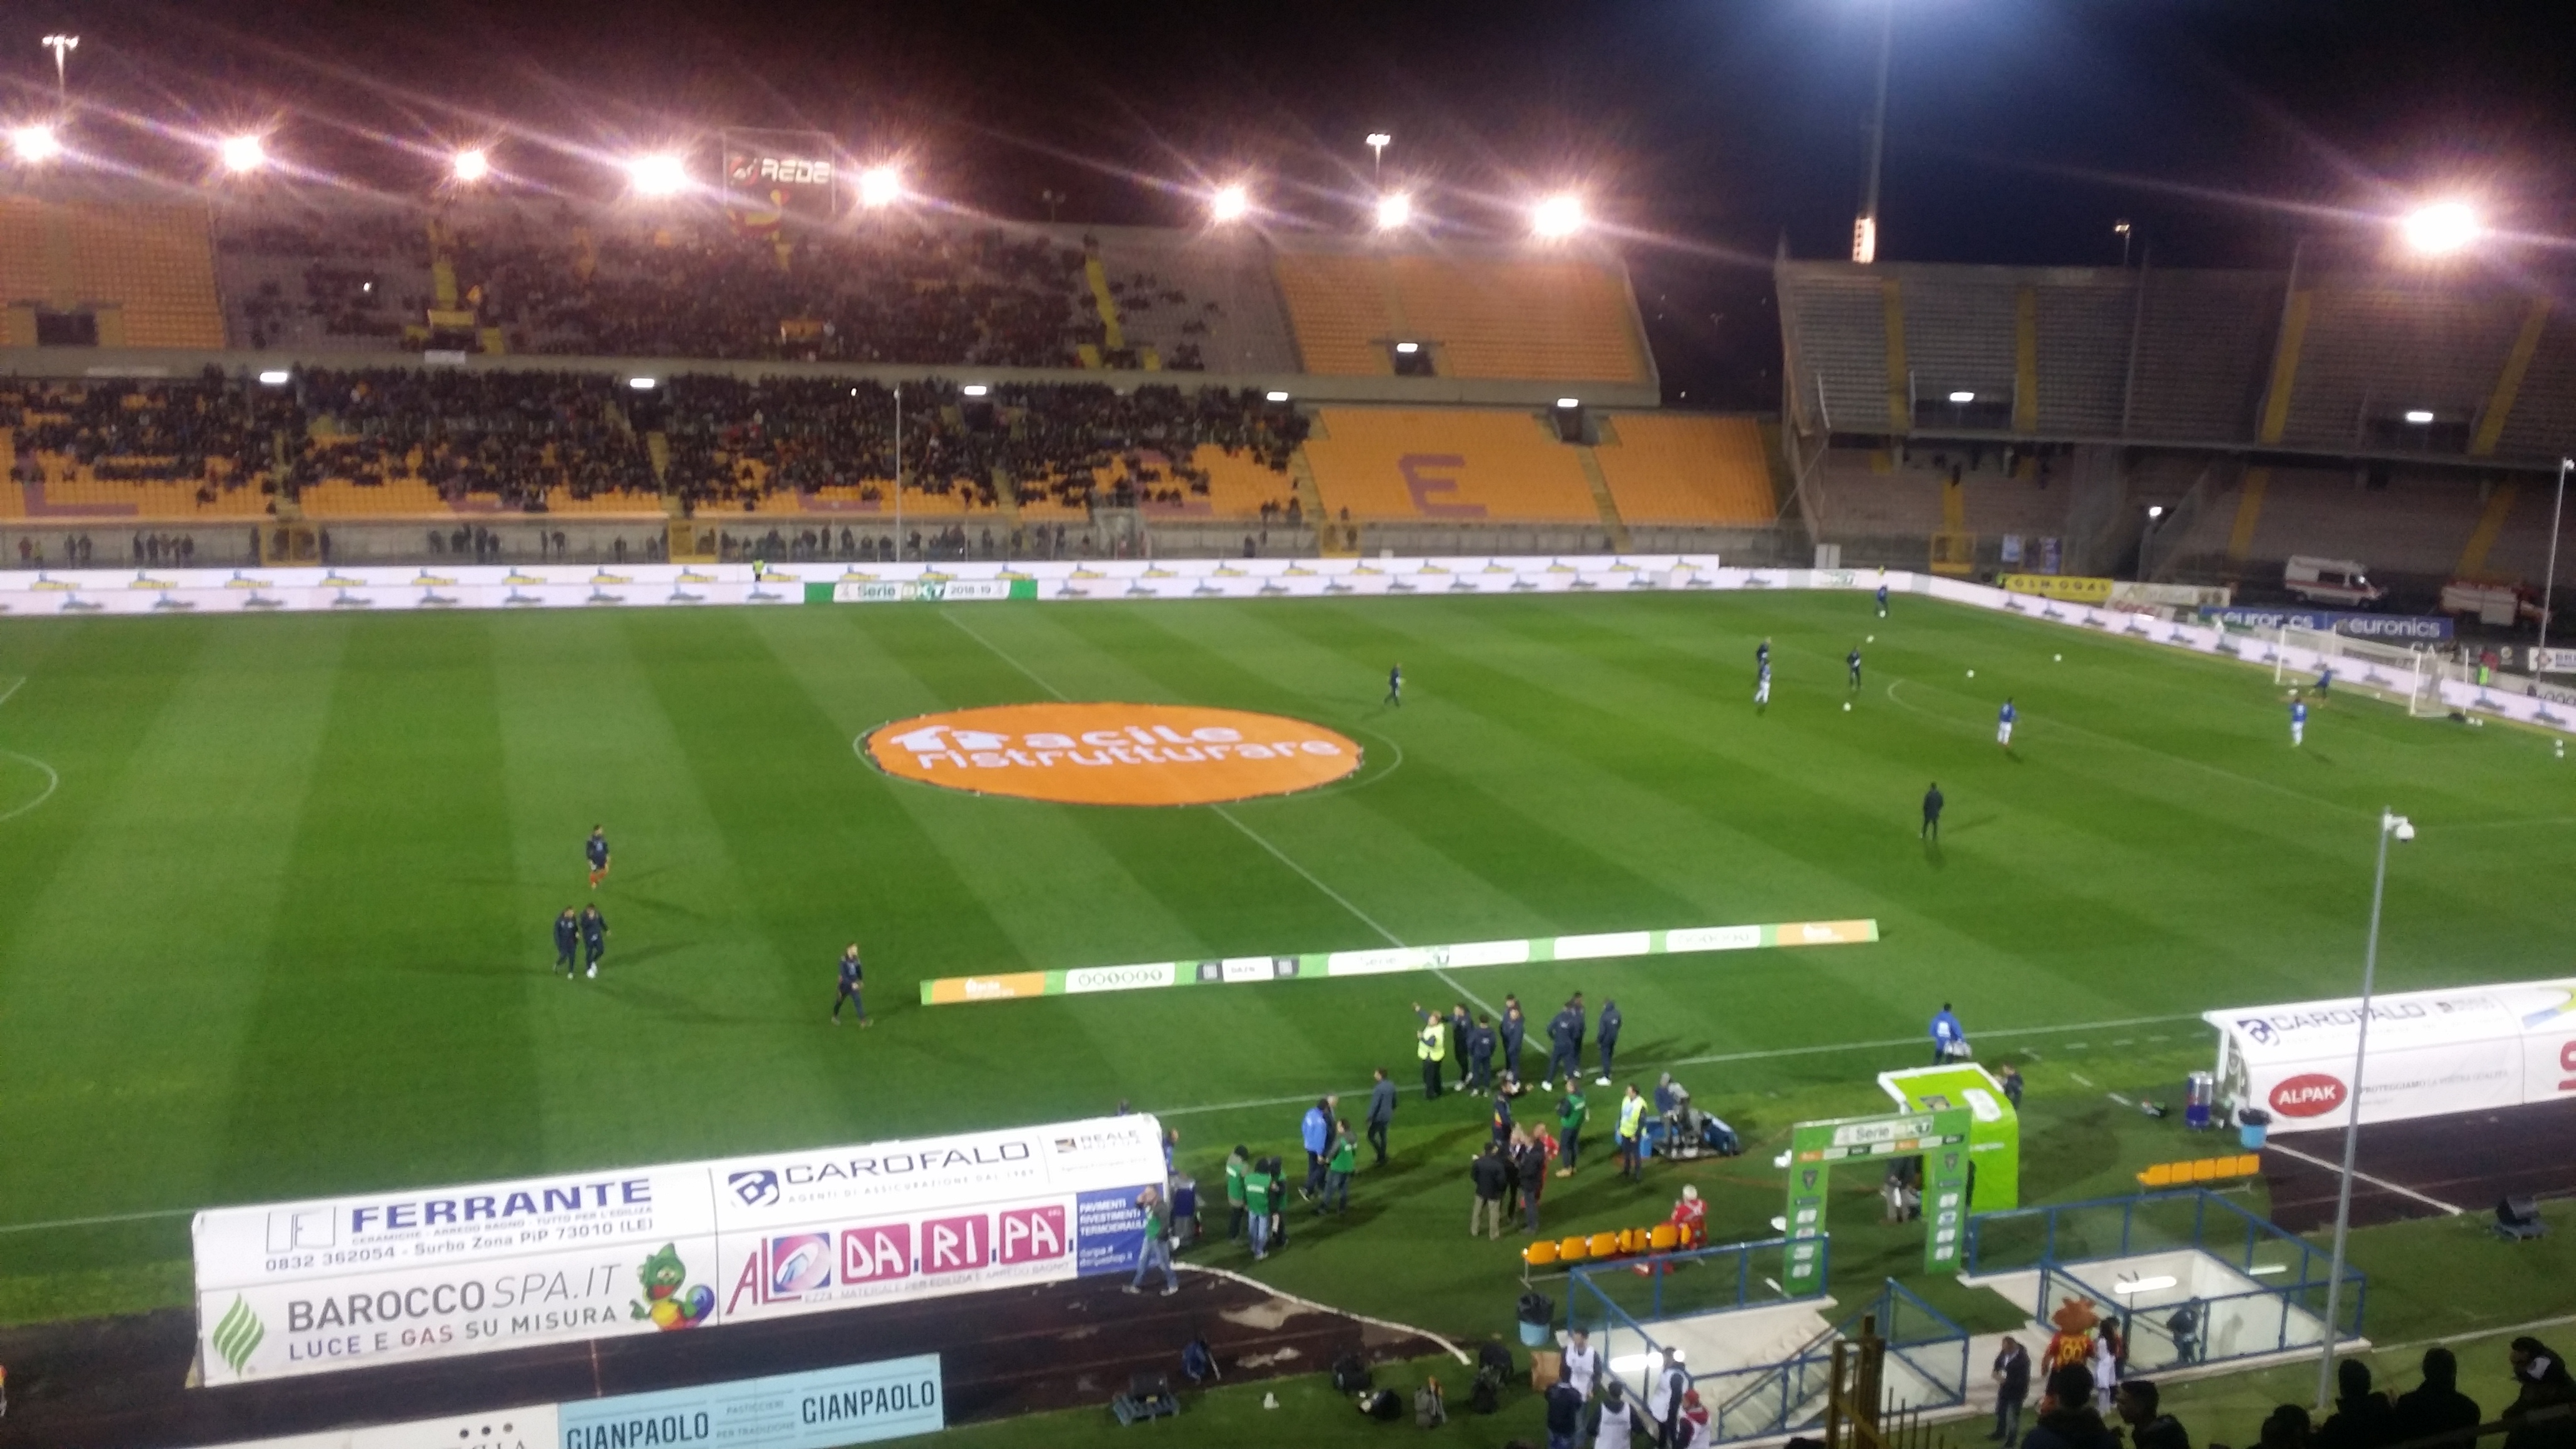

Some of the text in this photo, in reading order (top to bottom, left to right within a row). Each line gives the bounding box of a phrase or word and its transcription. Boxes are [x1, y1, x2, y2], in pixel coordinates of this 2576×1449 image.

[2349, 616, 2441, 637] euronics
[2278, 1084, 2337, 1106] ALPAK
[352, 1178, 651, 1234] FERRANTE
[788, 1190, 837, 1204] AGENTI
[844, 1188, 857, 1198] DI
[1080, 1198, 1126, 1214] PAVIMENTI
[351, 1231, 421, 1245] CERAMICHE
[434, 1225, 481, 1237] ARREDO
[575, 1211, 597, 1221] PER
[1080, 1208, 1141, 1224] RIVESTIMENTI
[265, 1255, 315, 1271] 0832
[322, 1246, 395, 1266] 362054
[472, 1236, 513, 1249] Zona
[555, 1222, 613, 1239] 73010
[620, 1218, 653, 1232] (LE)
[289, 1304, 618, 1361] LUCE E GAS SU MISURA
[802, 1380, 935, 1424] GIANPAOLO
[567, 1411, 709, 1448] GIANPAOLO
